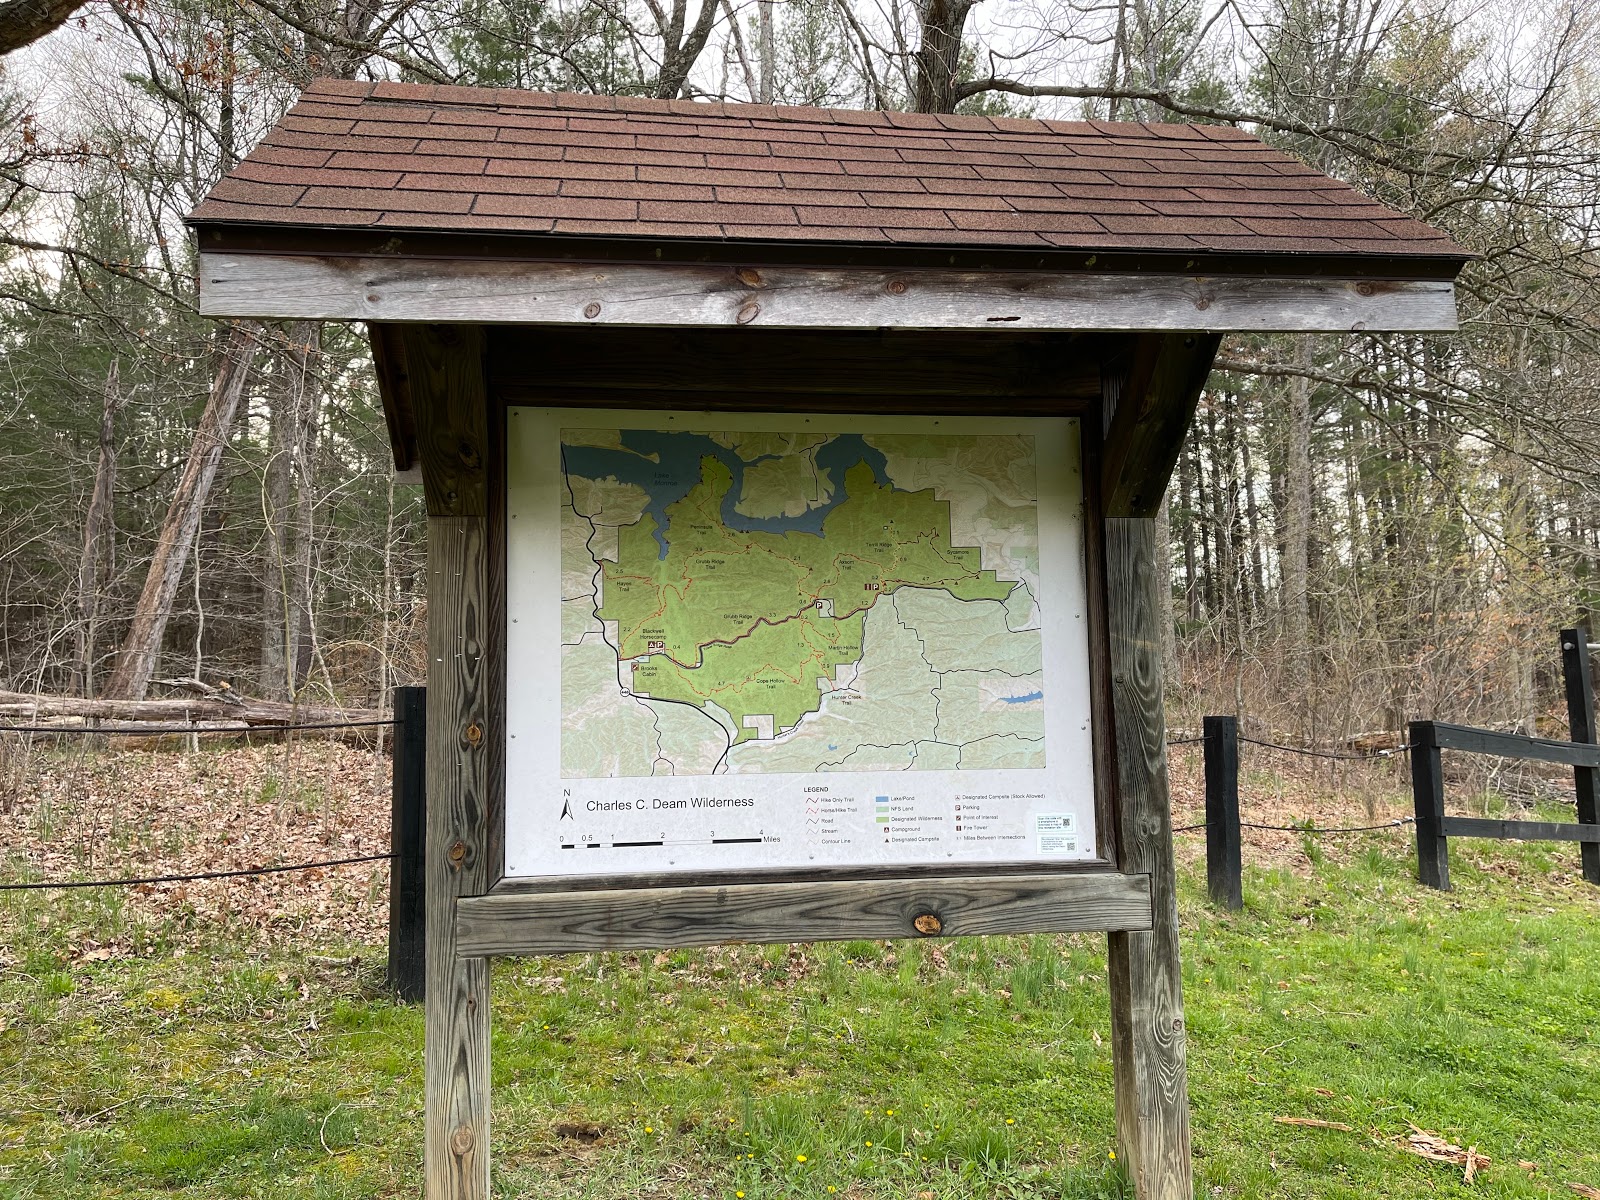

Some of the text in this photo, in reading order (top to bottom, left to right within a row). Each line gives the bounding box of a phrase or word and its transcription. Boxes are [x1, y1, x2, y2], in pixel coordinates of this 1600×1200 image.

[586, 797, 754, 811] Charles C. Deam Wilderness
